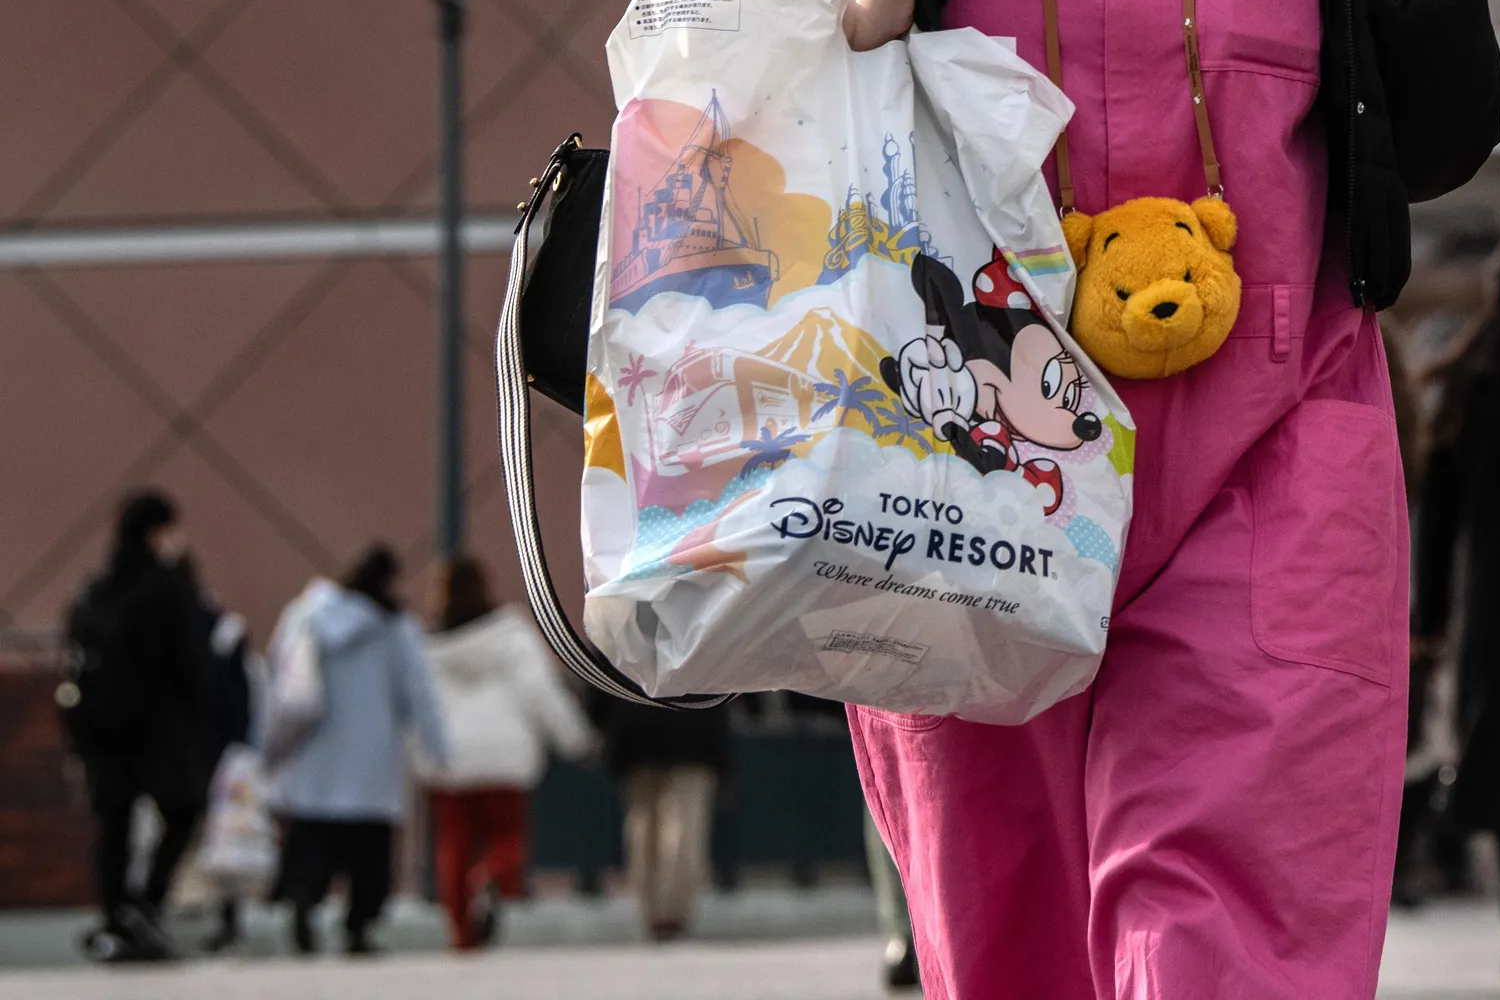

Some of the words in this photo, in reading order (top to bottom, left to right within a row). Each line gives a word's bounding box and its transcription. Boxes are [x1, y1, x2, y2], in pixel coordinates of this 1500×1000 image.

[879, 492, 963, 525] TOKYO
[926, 528, 1053, 577] RESORT
[813, 560, 873, 587] Where
[874, 574, 938, 600] dreams
[939, 590, 983, 609] come
[984, 596, 1020, 614] true
